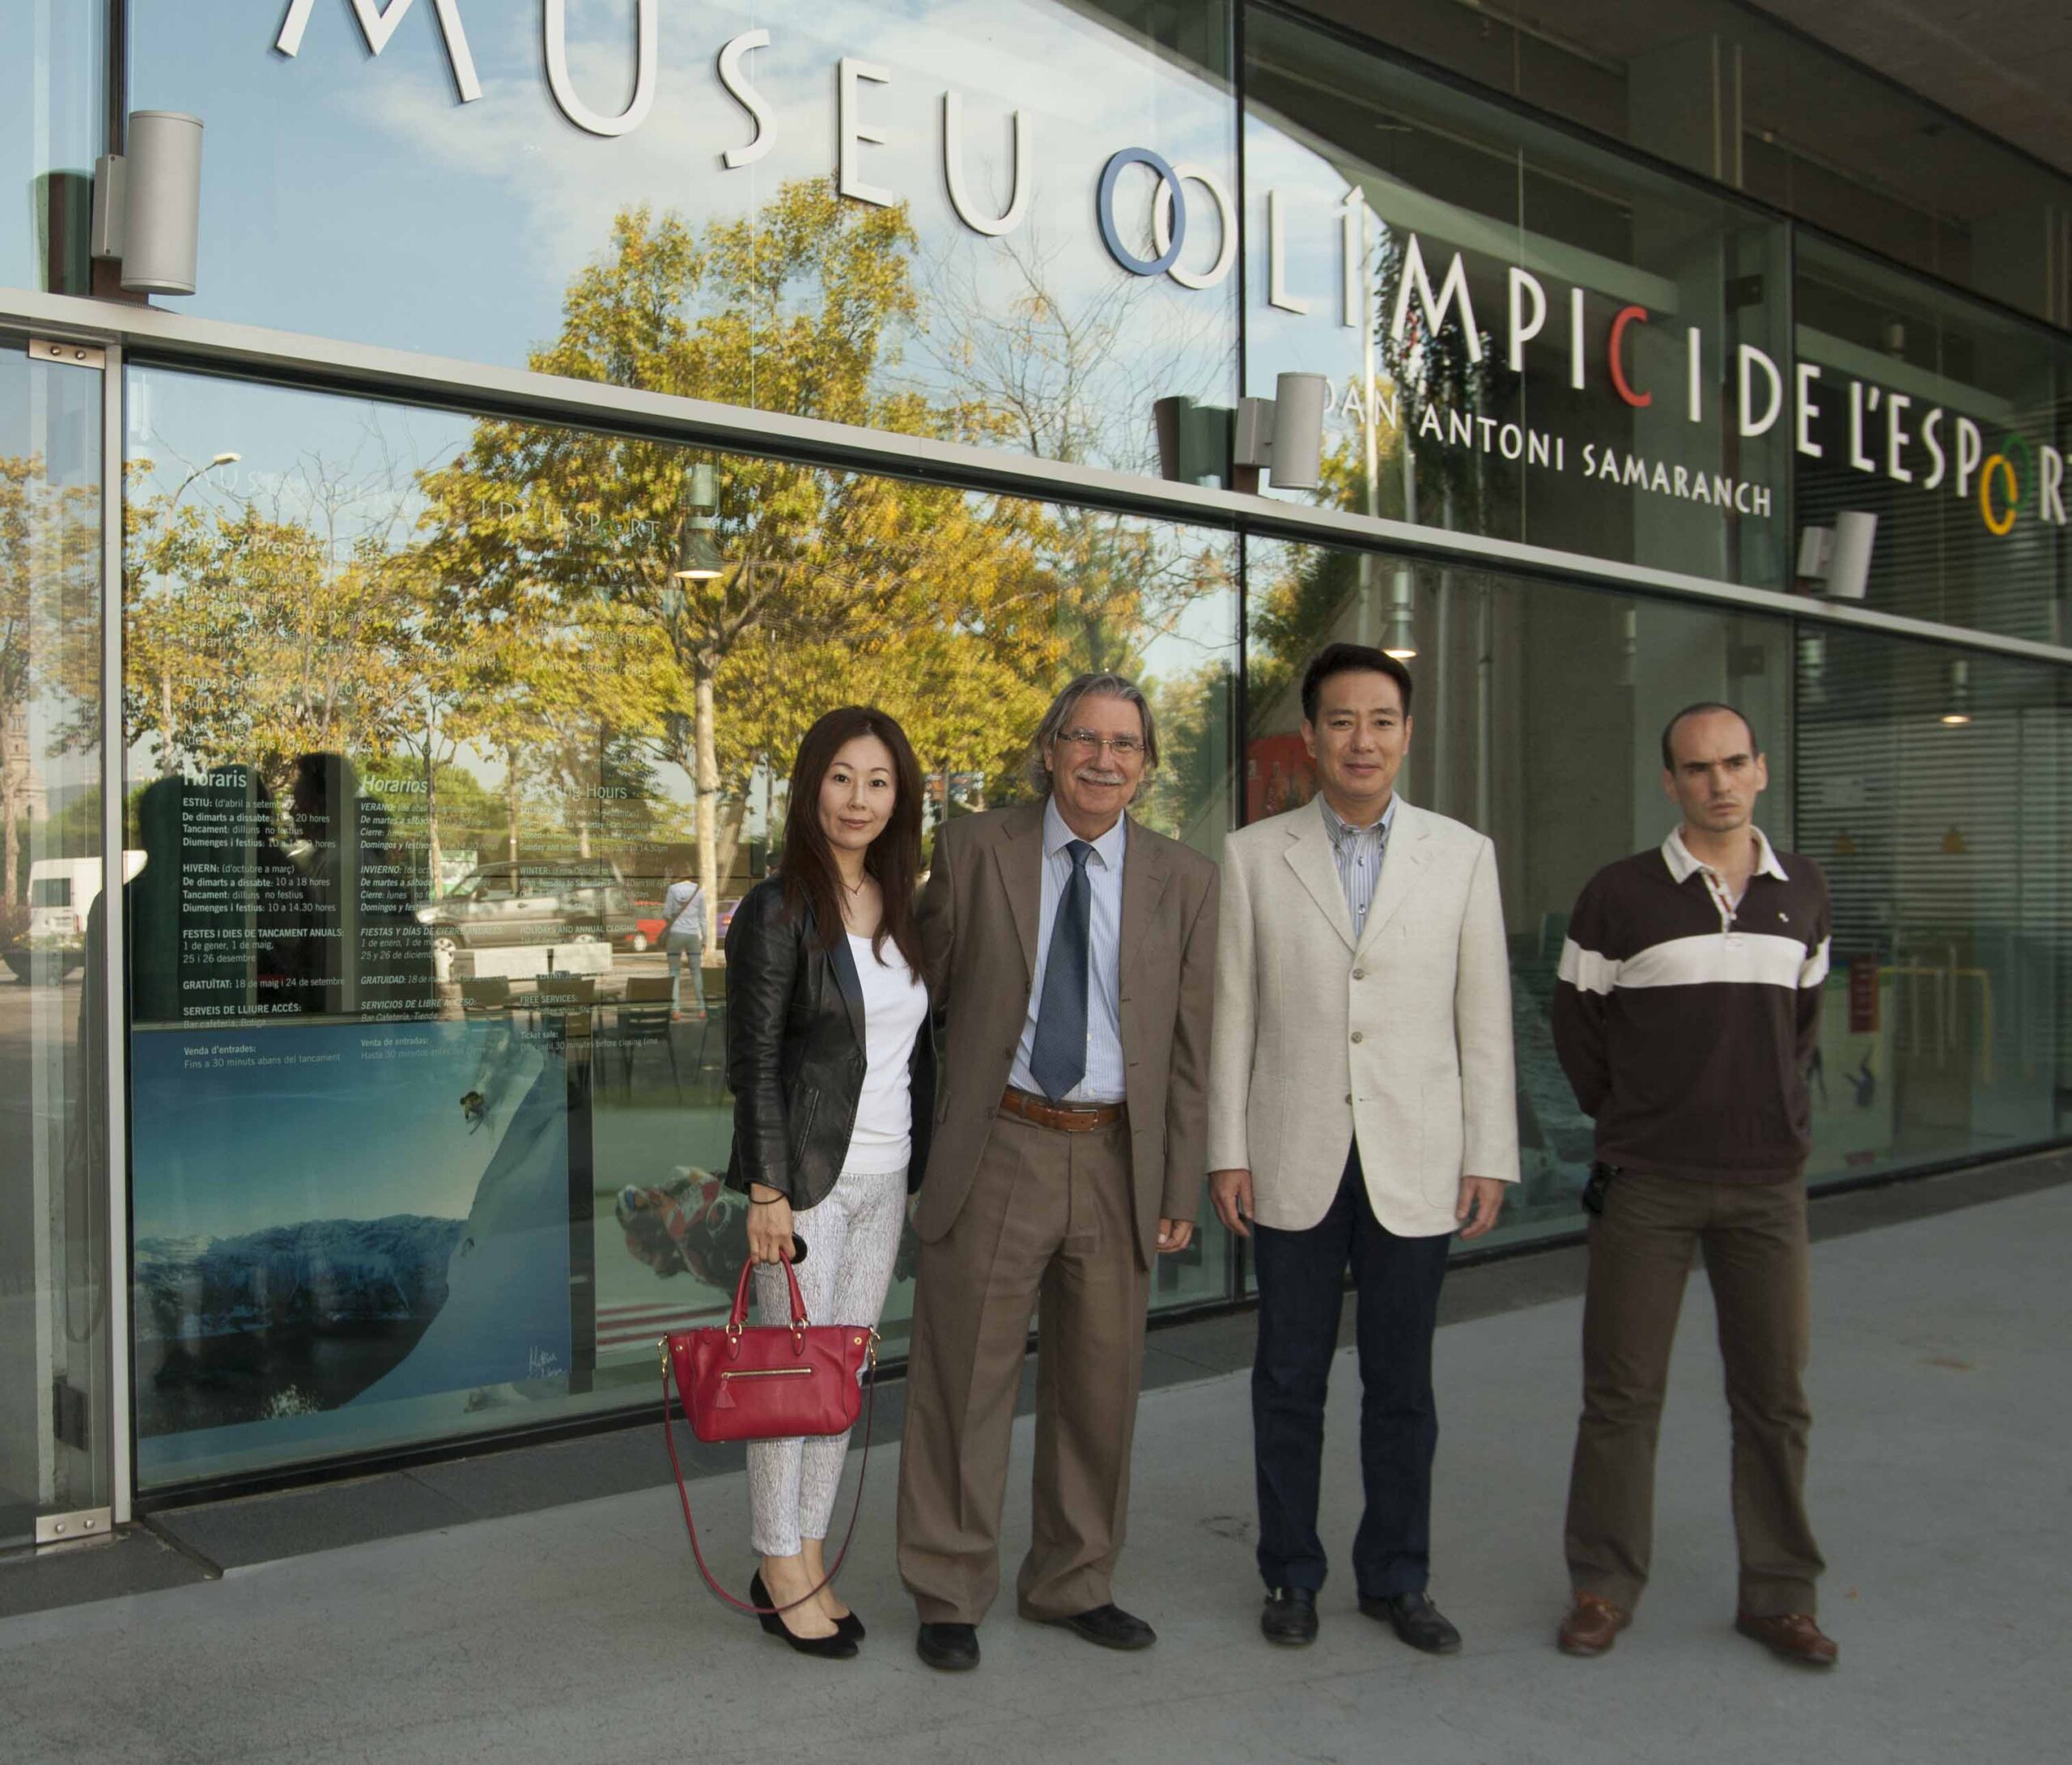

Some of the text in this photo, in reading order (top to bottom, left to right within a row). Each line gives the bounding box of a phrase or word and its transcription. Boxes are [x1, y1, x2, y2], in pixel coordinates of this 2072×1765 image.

[1688, 327, 1701, 423] I
[1738, 343, 1823, 459] DE
[1419, 403, 1565, 472] ANTONI
[1582, 443, 1773, 519] SAMARANCH
[184, 771, 247, 787] Horaris
[362, 775, 427, 793] Horarios
[587, 783, 627, 798] Hours
[183, 799, 244, 809] ESTIU: (d'abril
[183, 812, 193, 821] De
[196, 813, 227, 821] dimarts
[236, 813, 273, 821] dissabte:
[296, 814, 307, 822] 20
[309, 814, 330, 822] hores
[373, 816, 395, 824] martes
[183, 825, 230, 834] Tancament:
[233, 825, 260, 834] dilluns
[183, 838, 227, 849] Diumenges
[236, 839, 265, 847] festius:
[315, 840, 336, 848] hores
[360, 841, 402, 850] Domingos y
[183, 864, 219, 872] HIVERN:
[222, 864, 262, 875] (d'octubre
[272, 865, 295, 875] març)
[183, 877, 193, 885] De
[197, 877, 227, 885] dimarts
[237, 877, 274, 885] dissabte:
[183, 890, 230, 898] Tancament:
[183, 904, 227, 914] Diumenges
[361, 903, 402, 913] Domingos y
[183, 928, 345, 938] FESTES DIES DE TANCAMENT ANUALS:
[402, 927, 421, 936] DÍAS
[424, 927, 434, 936] DE
[558, 925, 572, 933] AND
[575, 925, 605, 933] ANNUAL
[368, 939, 377, 947] de
[183, 955, 195, 963] 25
[217, 954, 257, 962] desembre
[373, 951, 377, 961] y
[380, 951, 390, 959] 26
[393, 951, 401, 959] de
[236, 980, 245, 988] 18
[248, 979, 257, 987] de
[260, 979, 278, 990] maig
[287, 978, 296, 986] 24
[299, 978, 308, 986] de
[310, 978, 346, 986] setembre
[361, 976, 405, 984] GRATUIDAD:
[361, 999, 441, 1009] SERVICIOS DE LIBRE
[541, 995, 578, 1003] SERVICES:
[183, 1007, 220, 1016] SERVEIS
[223, 1006, 235, 1015] DE
[238, 1005, 269, 1014] LLIURE
[520, 1031, 541, 1039] Ticket
[361, 1038, 382, 1046] Venta
[619, 1039, 641, 1048] closing
[184, 1045, 256, 1055] Venda d'entrades:
[185, 1060, 202, 1068] Fins
[227, 1058, 256, 1067] minuts
[257, 1056, 282, 1065] abans
[299, 1054, 341, 1063] tancament
